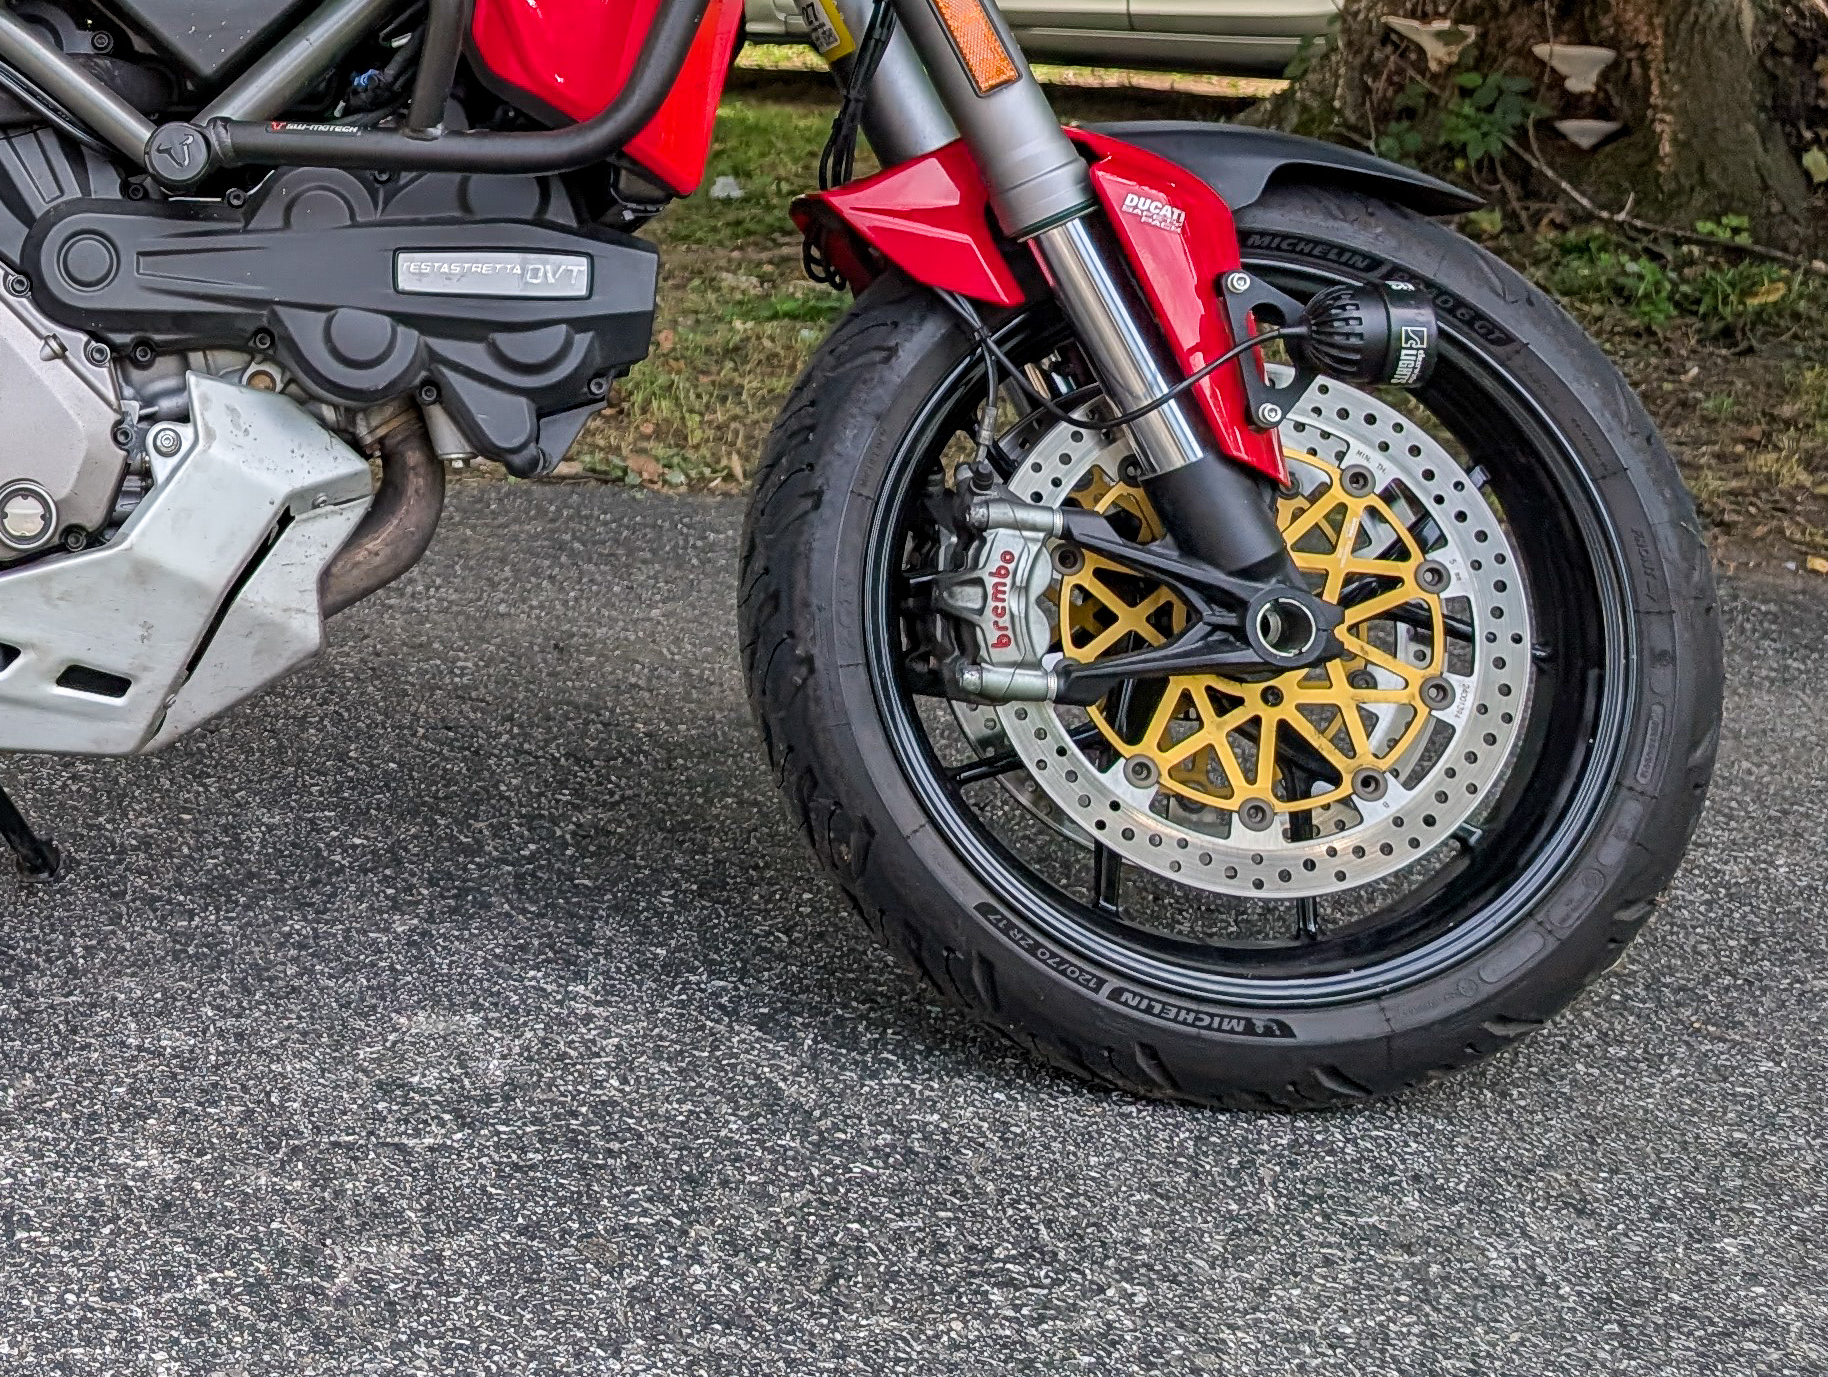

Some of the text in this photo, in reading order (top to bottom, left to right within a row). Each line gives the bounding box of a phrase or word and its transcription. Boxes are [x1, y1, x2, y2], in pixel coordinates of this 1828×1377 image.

[1124, 193, 1185, 223] DUCATI
[1247, 234, 1370, 269] MICHELIN
[402, 261, 586, 285] TESTASTRETTA DVT
[988, 549, 1015, 649] brembo
[986, 911, 1246, 1033] MICHELIN 120/70 ZR 17
